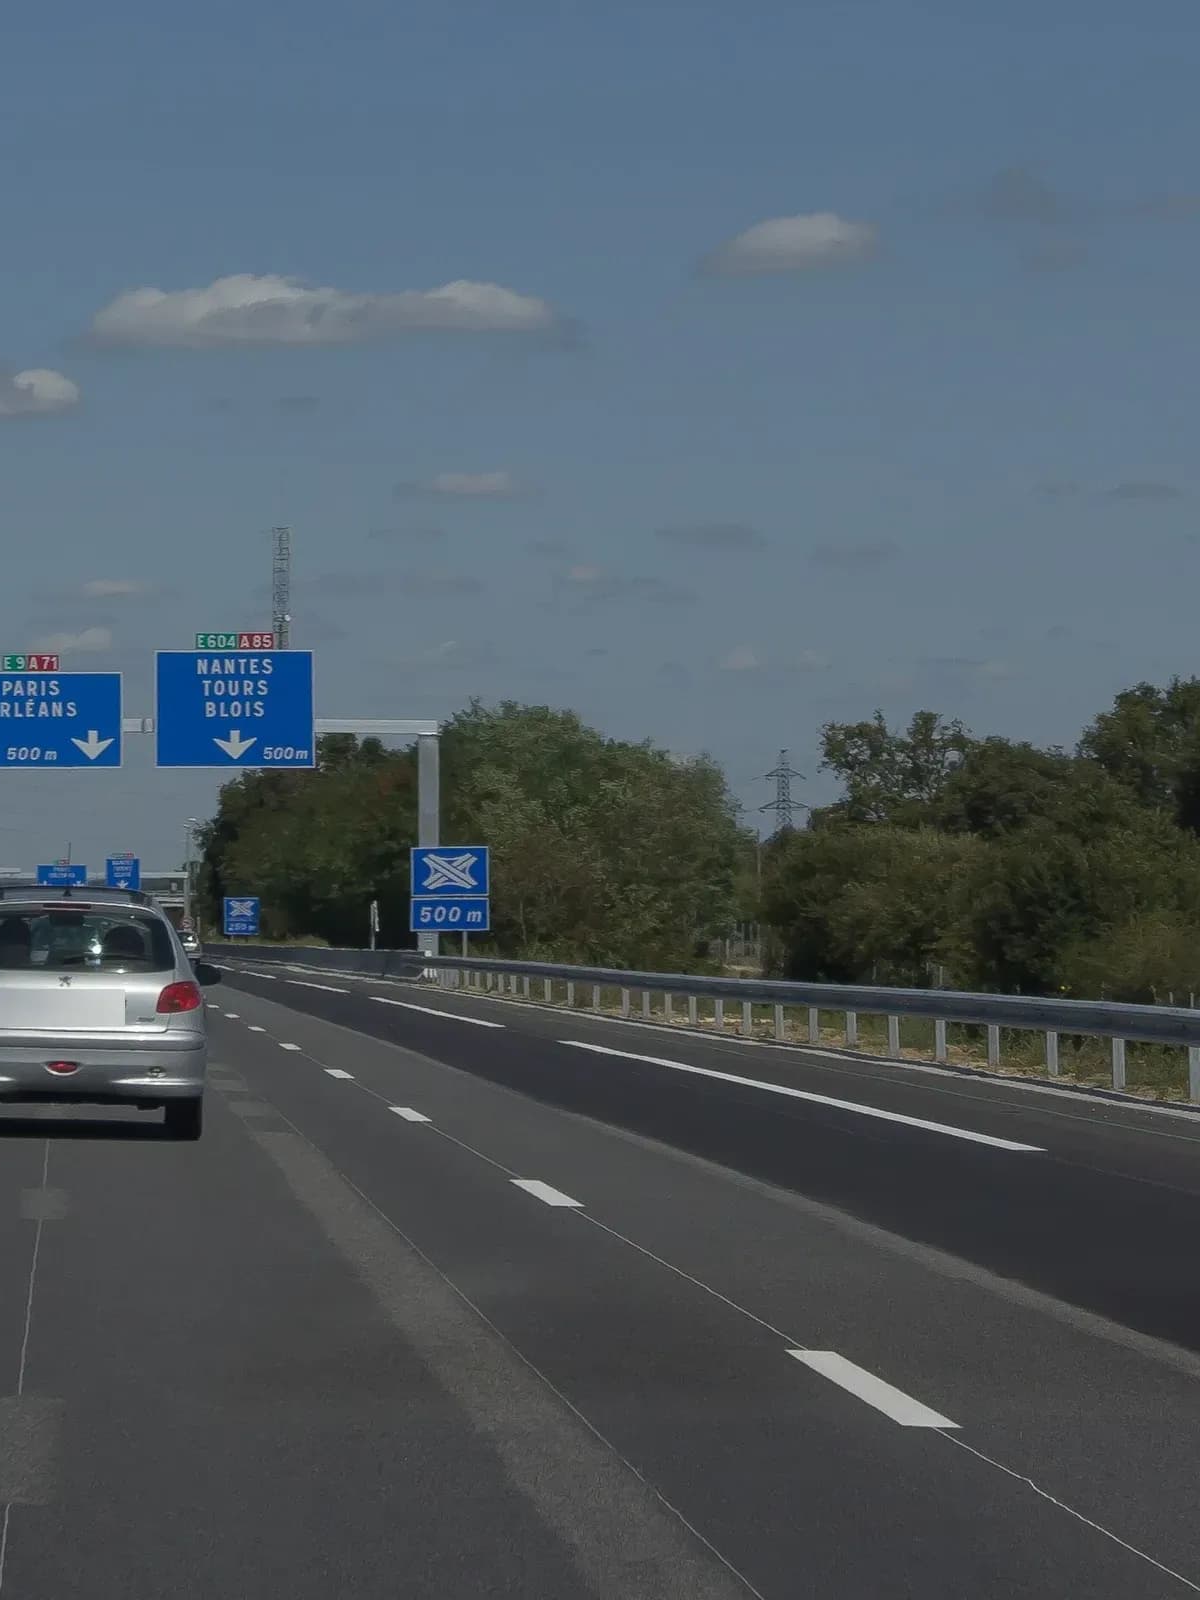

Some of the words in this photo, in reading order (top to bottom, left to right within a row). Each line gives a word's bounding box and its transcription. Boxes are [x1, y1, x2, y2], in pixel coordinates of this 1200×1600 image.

[197, 659, 273, 675] NANTES
[1, 680, 61, 697] PARIS
[202, 680, 268, 697] TOURS
[205, 702, 265, 718] BLOIS
[7, 747, 41, 761] 500
[44, 750, 57, 761] m
[419, 906, 461, 923] 500
[466, 910, 482, 922] m
